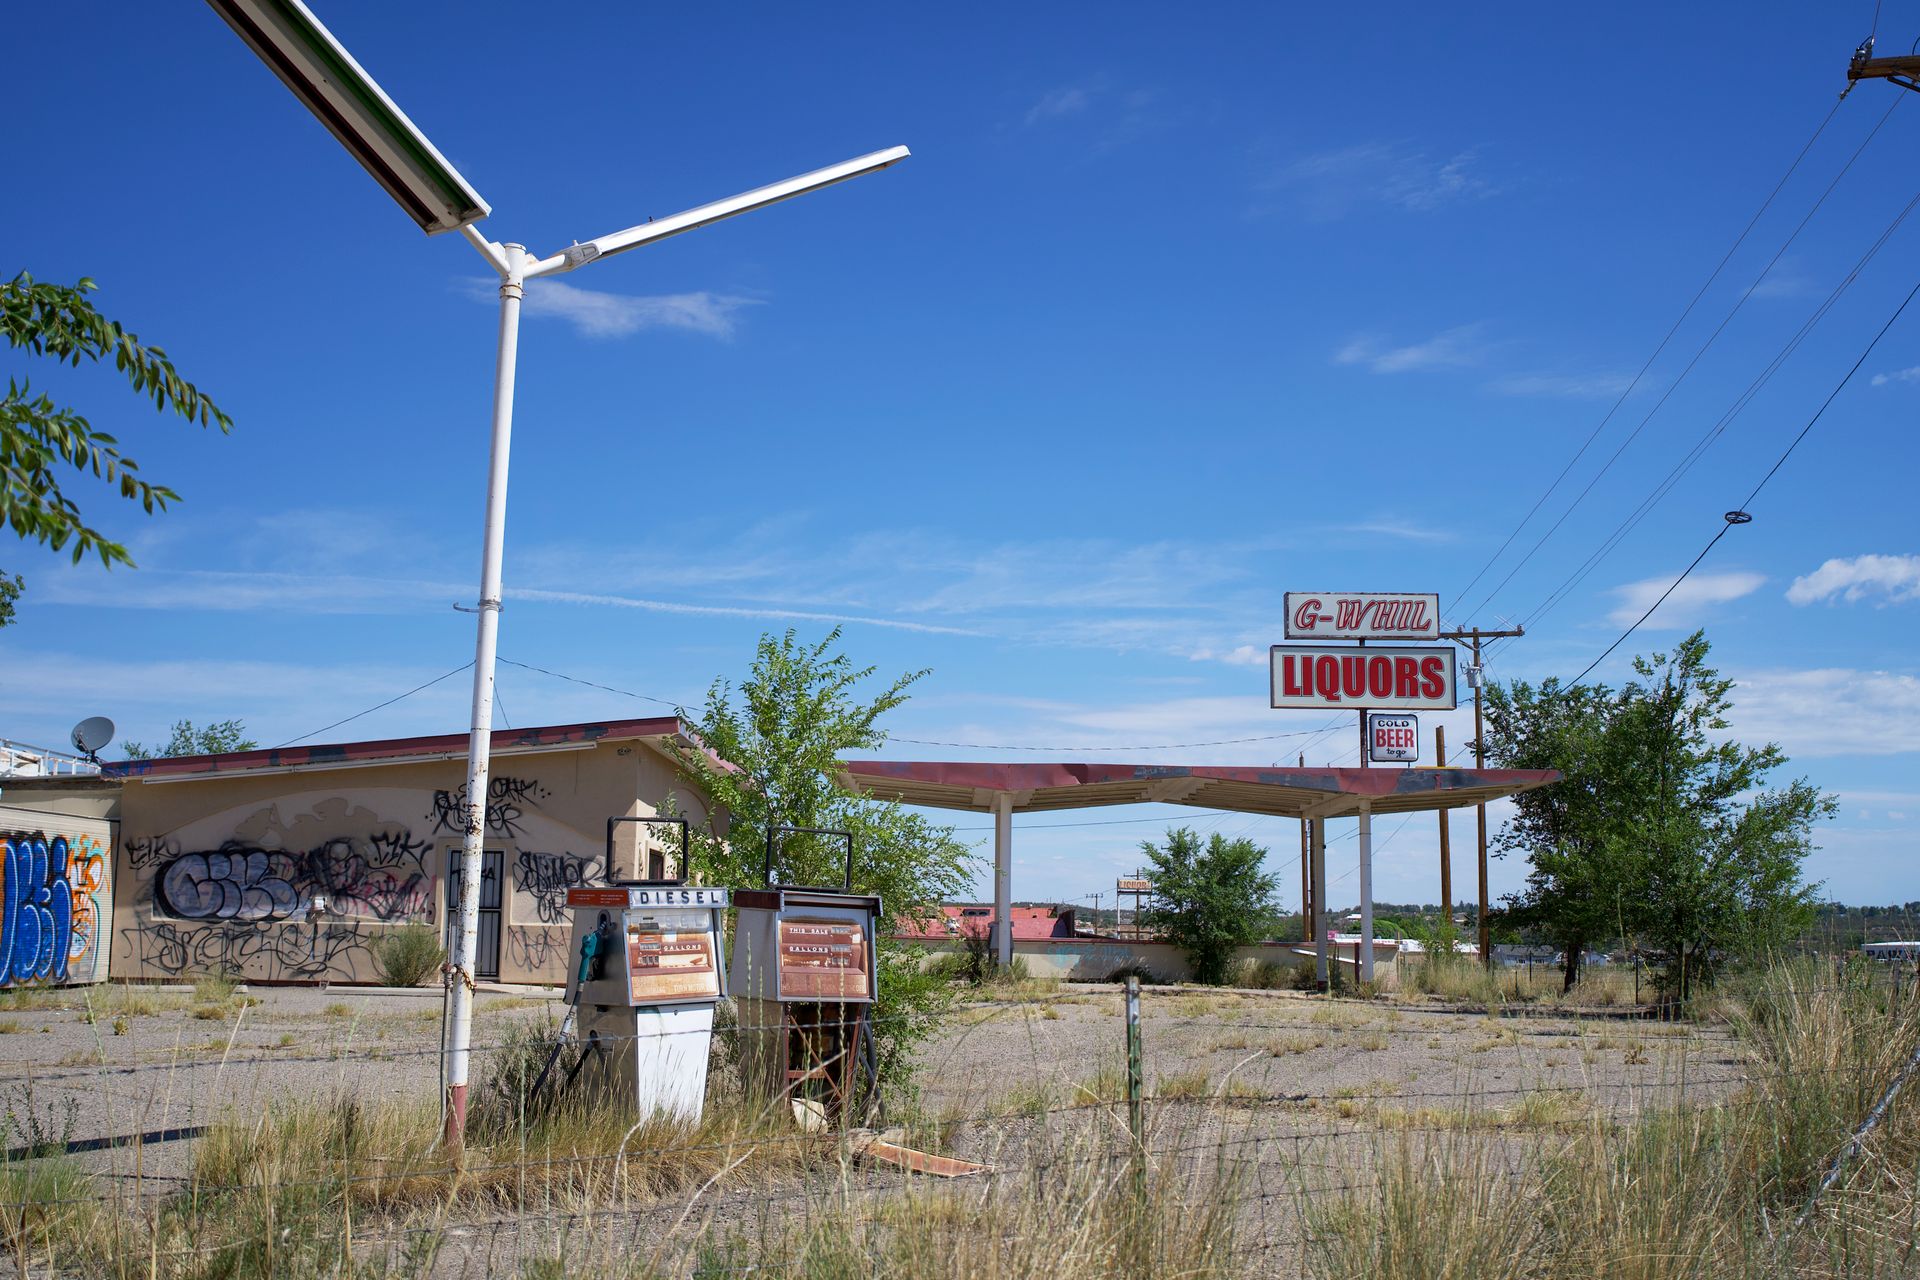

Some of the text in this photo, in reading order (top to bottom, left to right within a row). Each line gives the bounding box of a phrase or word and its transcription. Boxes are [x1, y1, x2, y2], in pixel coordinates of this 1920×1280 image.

[1294, 598, 1432, 632] G-WHIL
[1282, 654, 1446, 702] LIQUORS
[1377, 719, 1410, 728] COLD
[1375, 728, 1415, 748] BEER
[1386, 747, 1407, 758] to go
[640, 891, 719, 905] DIESEL
[811, 927, 829, 935] SALE
[663, 943, 702, 952] GALLONS
[789, 945, 829, 953] GALLONS
